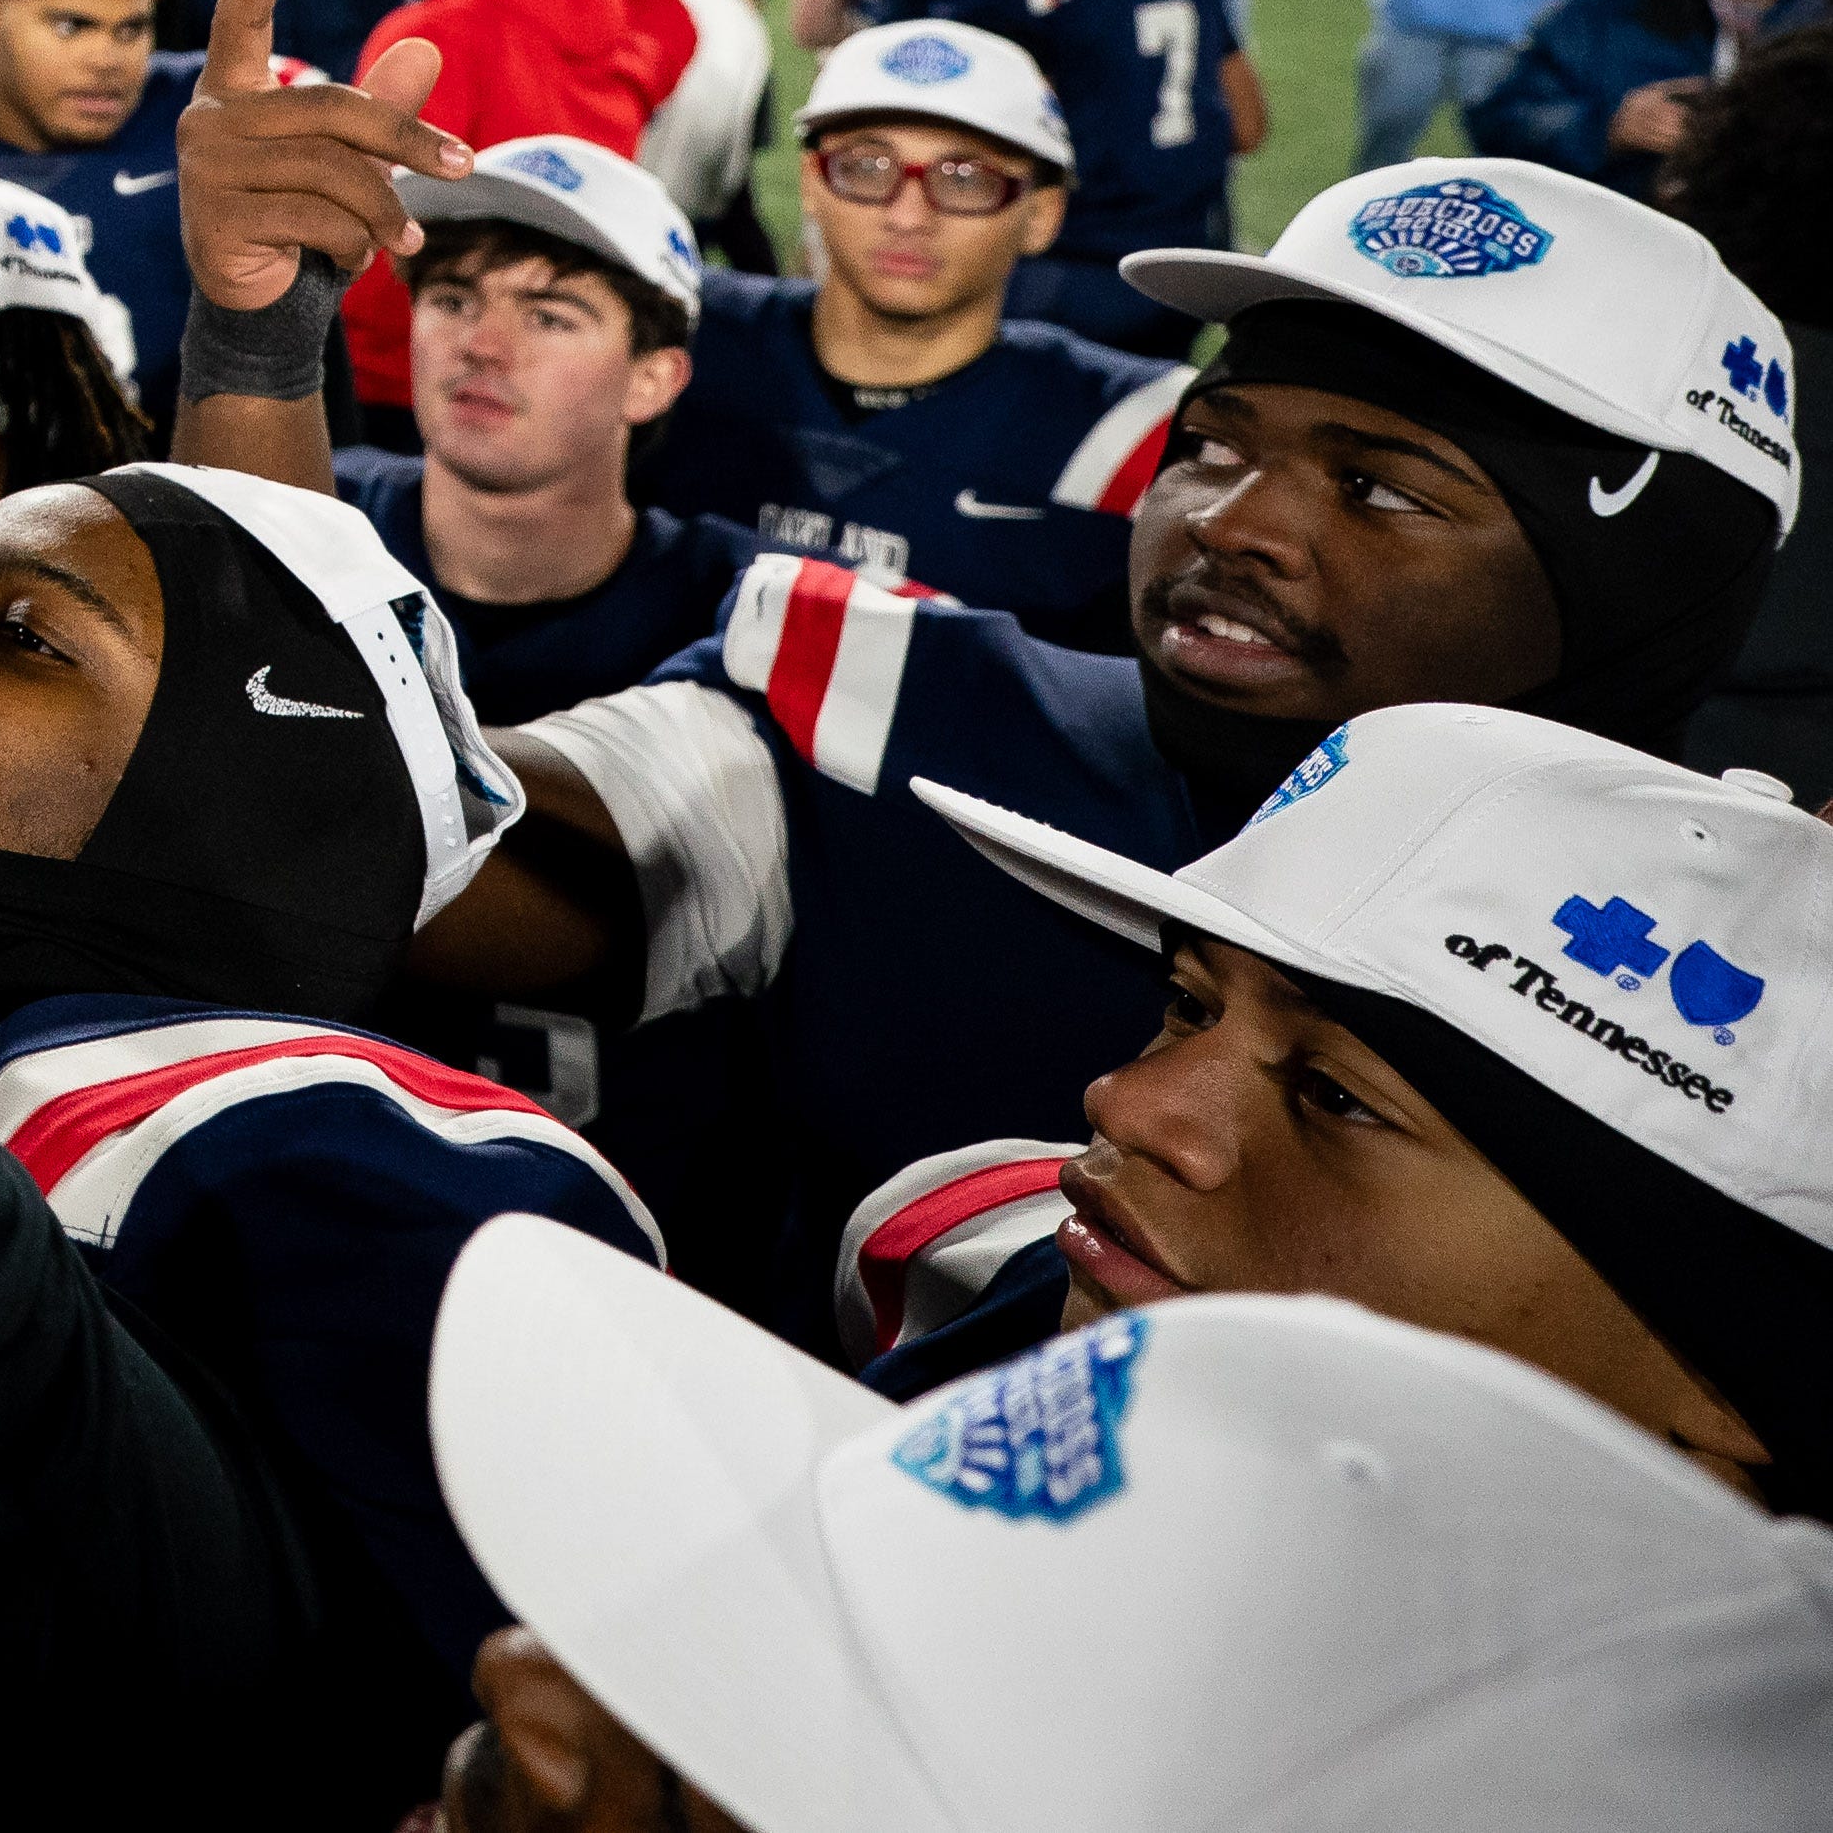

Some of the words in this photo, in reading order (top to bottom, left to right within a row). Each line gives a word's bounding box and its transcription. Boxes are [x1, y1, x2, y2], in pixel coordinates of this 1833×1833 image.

[1685, 389, 1716, 413] of
[1444, 933, 1513, 972] of
[1508, 955, 1734, 1115] Tennessee
